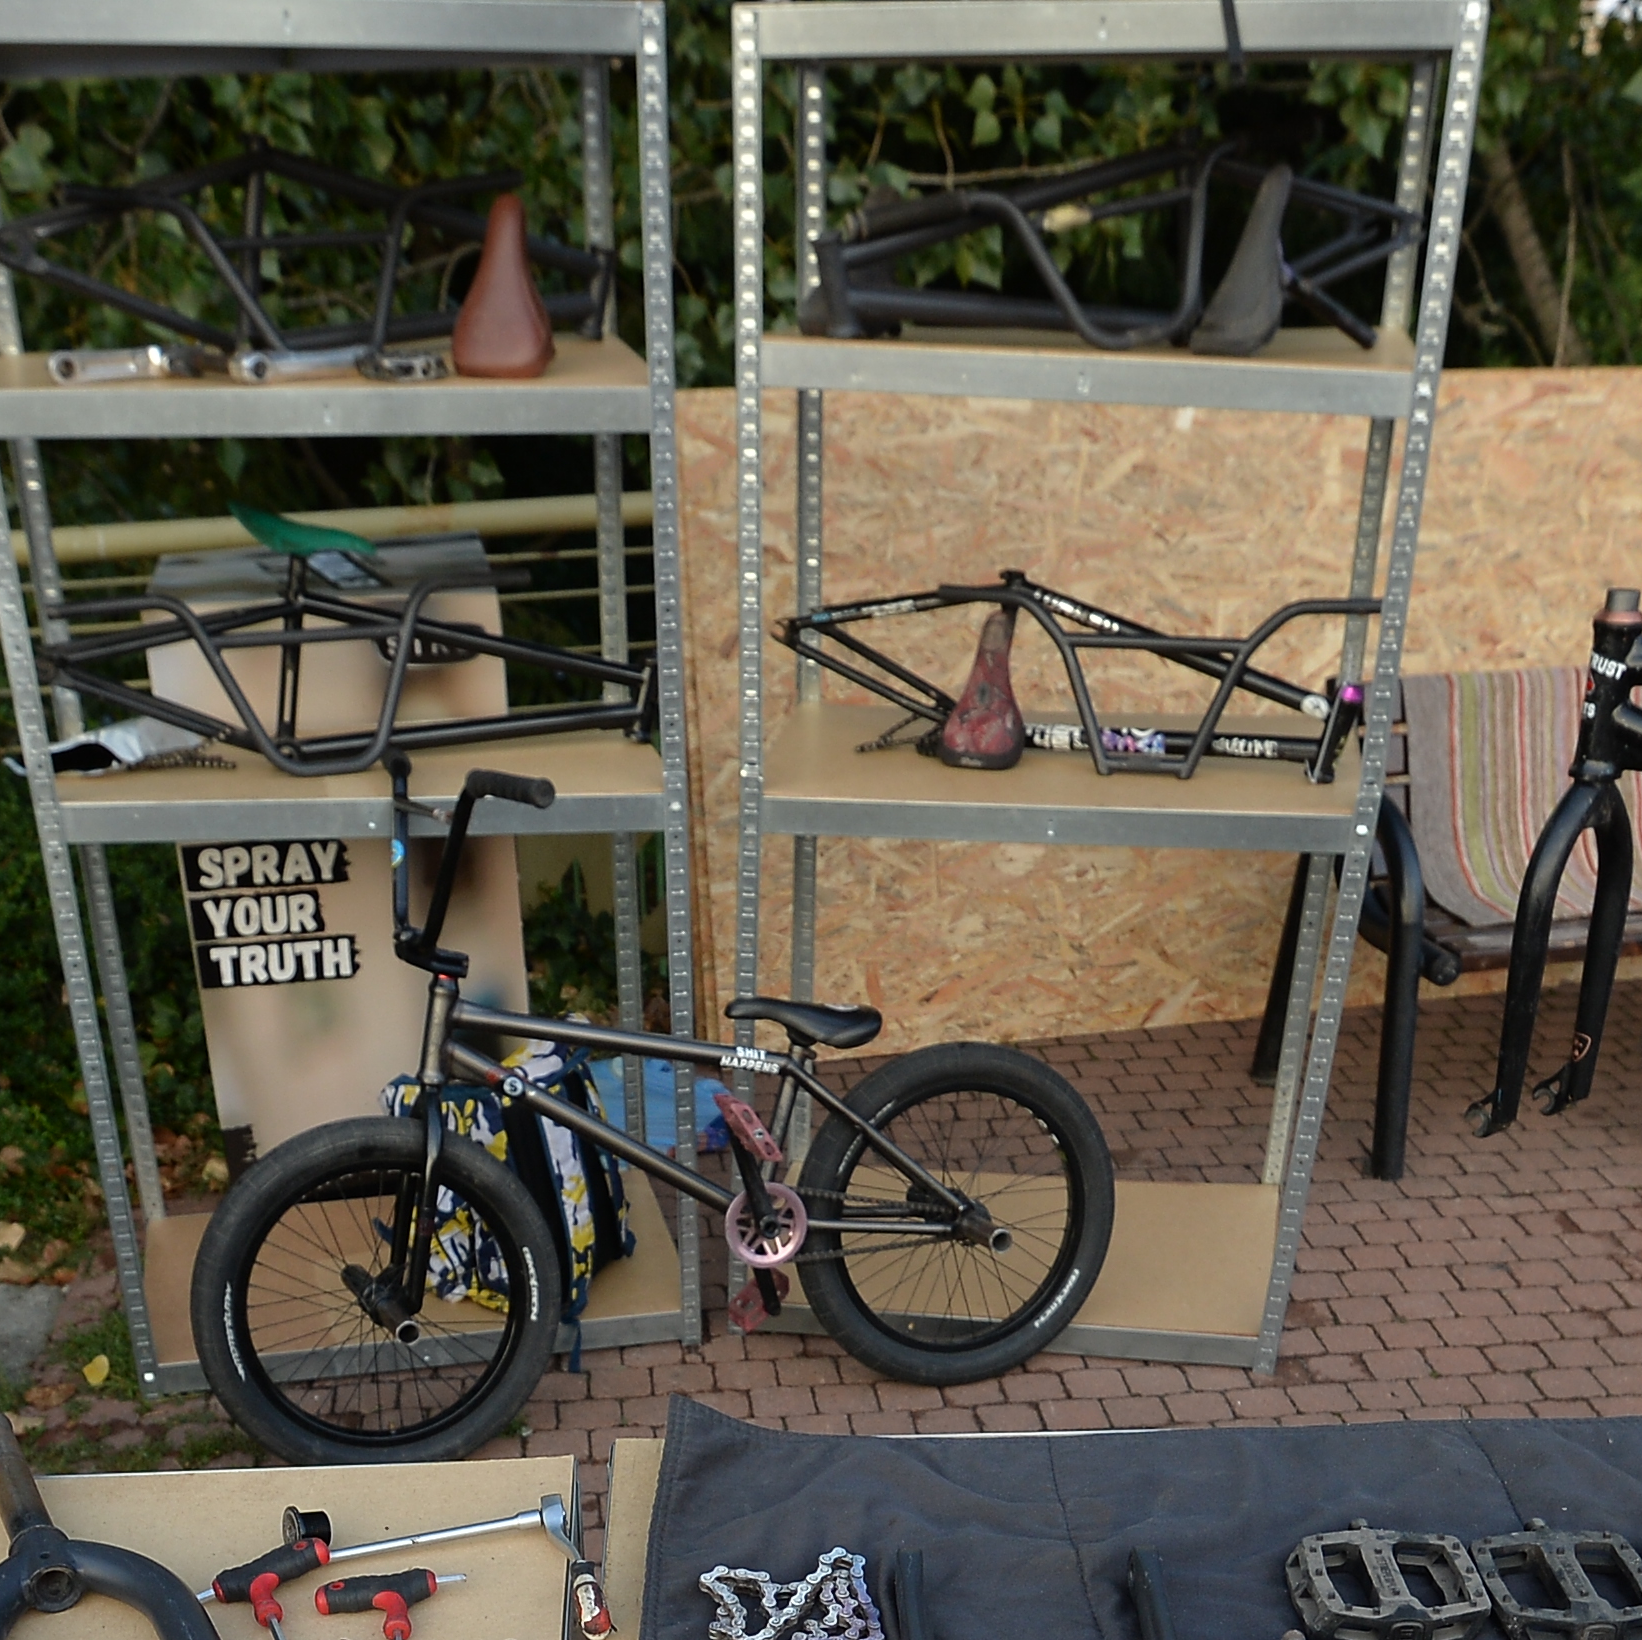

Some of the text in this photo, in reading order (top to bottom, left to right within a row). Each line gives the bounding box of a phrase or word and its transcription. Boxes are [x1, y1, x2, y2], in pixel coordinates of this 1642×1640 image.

[197, 840, 342, 888] SPRAY
[202, 893, 317, 938] YOUR
[209, 938, 353, 987] TRUTH
[720, 1055, 781, 1075] HAPPENS
[736, 1046, 767, 1061] SHIT
